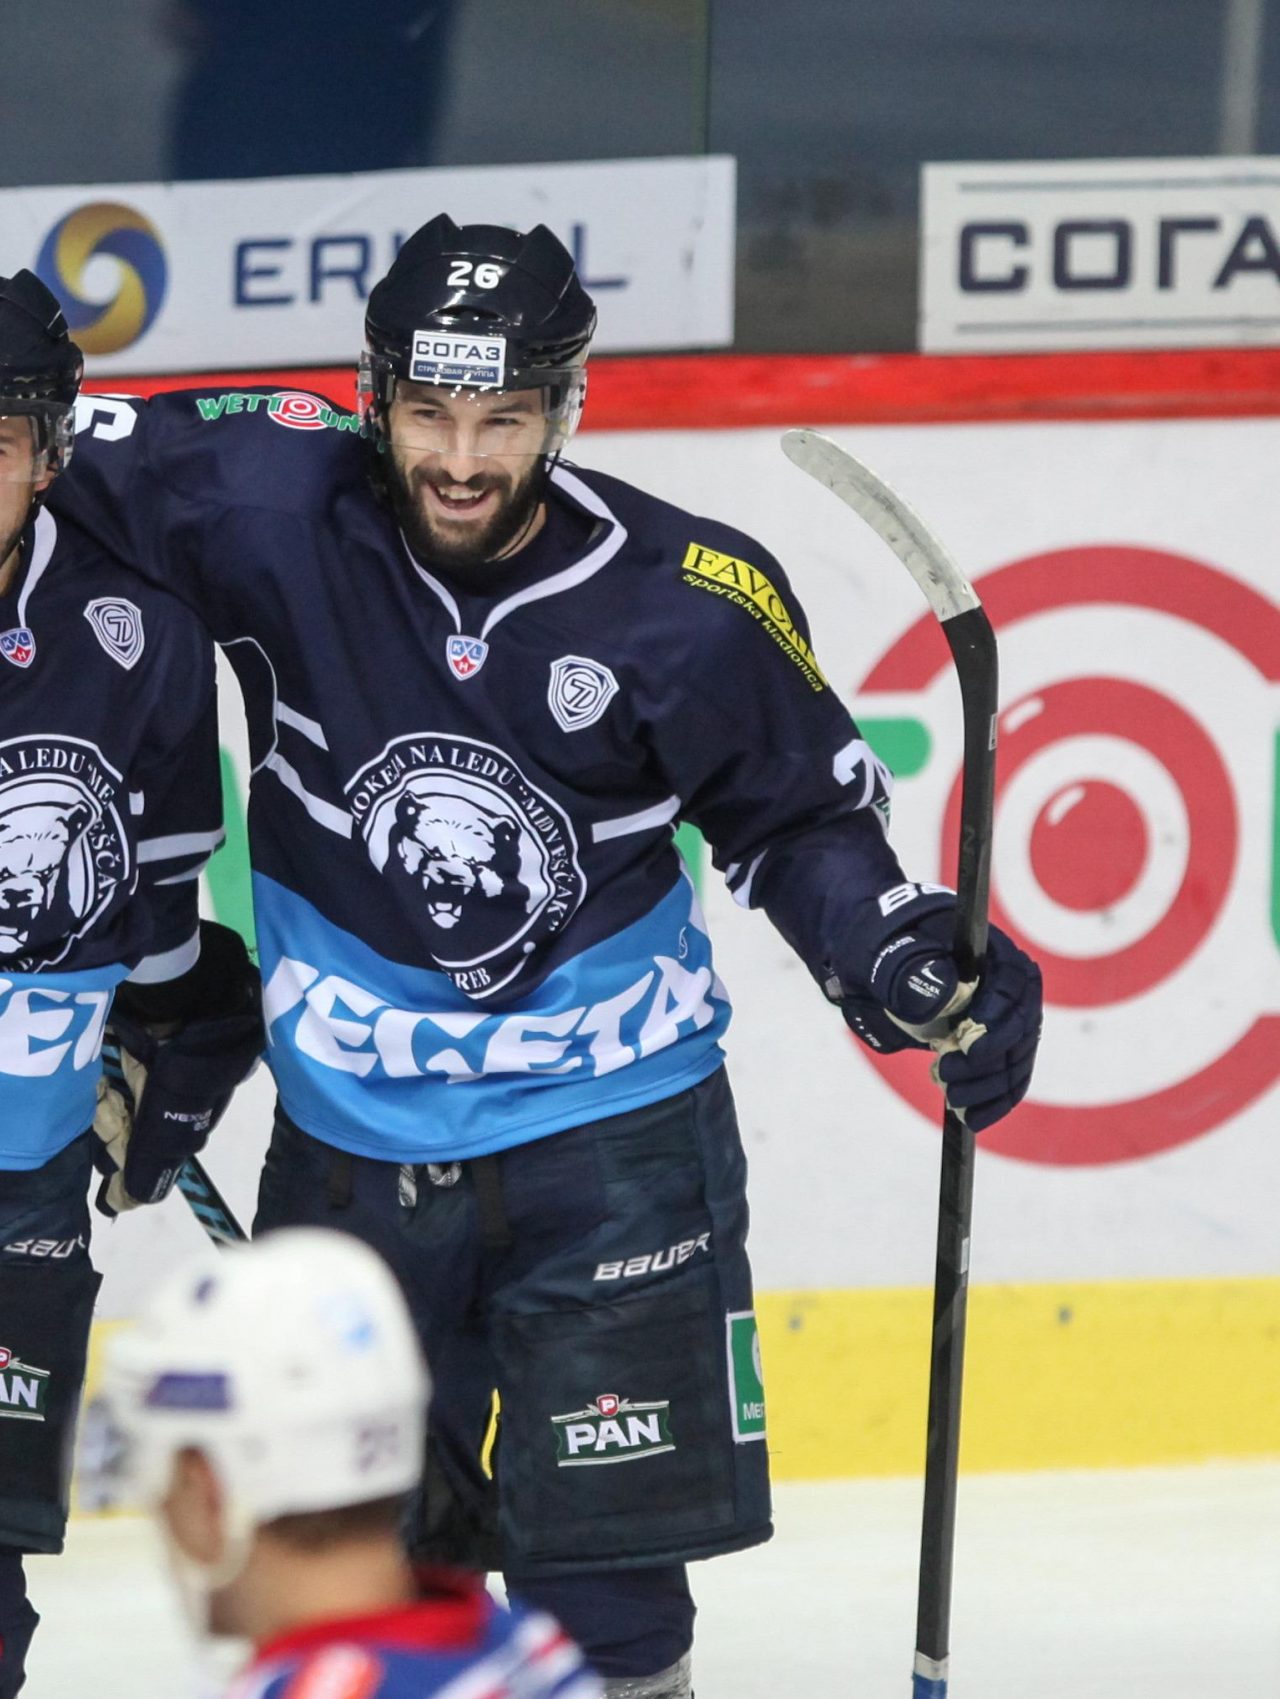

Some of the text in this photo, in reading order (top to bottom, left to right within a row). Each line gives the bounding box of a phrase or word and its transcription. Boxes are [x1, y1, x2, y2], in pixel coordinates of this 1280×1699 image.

[446, 261, 501, 290] 26
[416, 341, 500, 360] СОГАЗ
[683, 573, 824, 692] sportska kladionica
[18, 748, 86, 774] LEDU
[410, 745, 445, 765] NA
[450, 748, 516, 786] LEDU
[593, 1232, 711, 1281] BAUER
[565, 1413, 662, 1454] PAN
